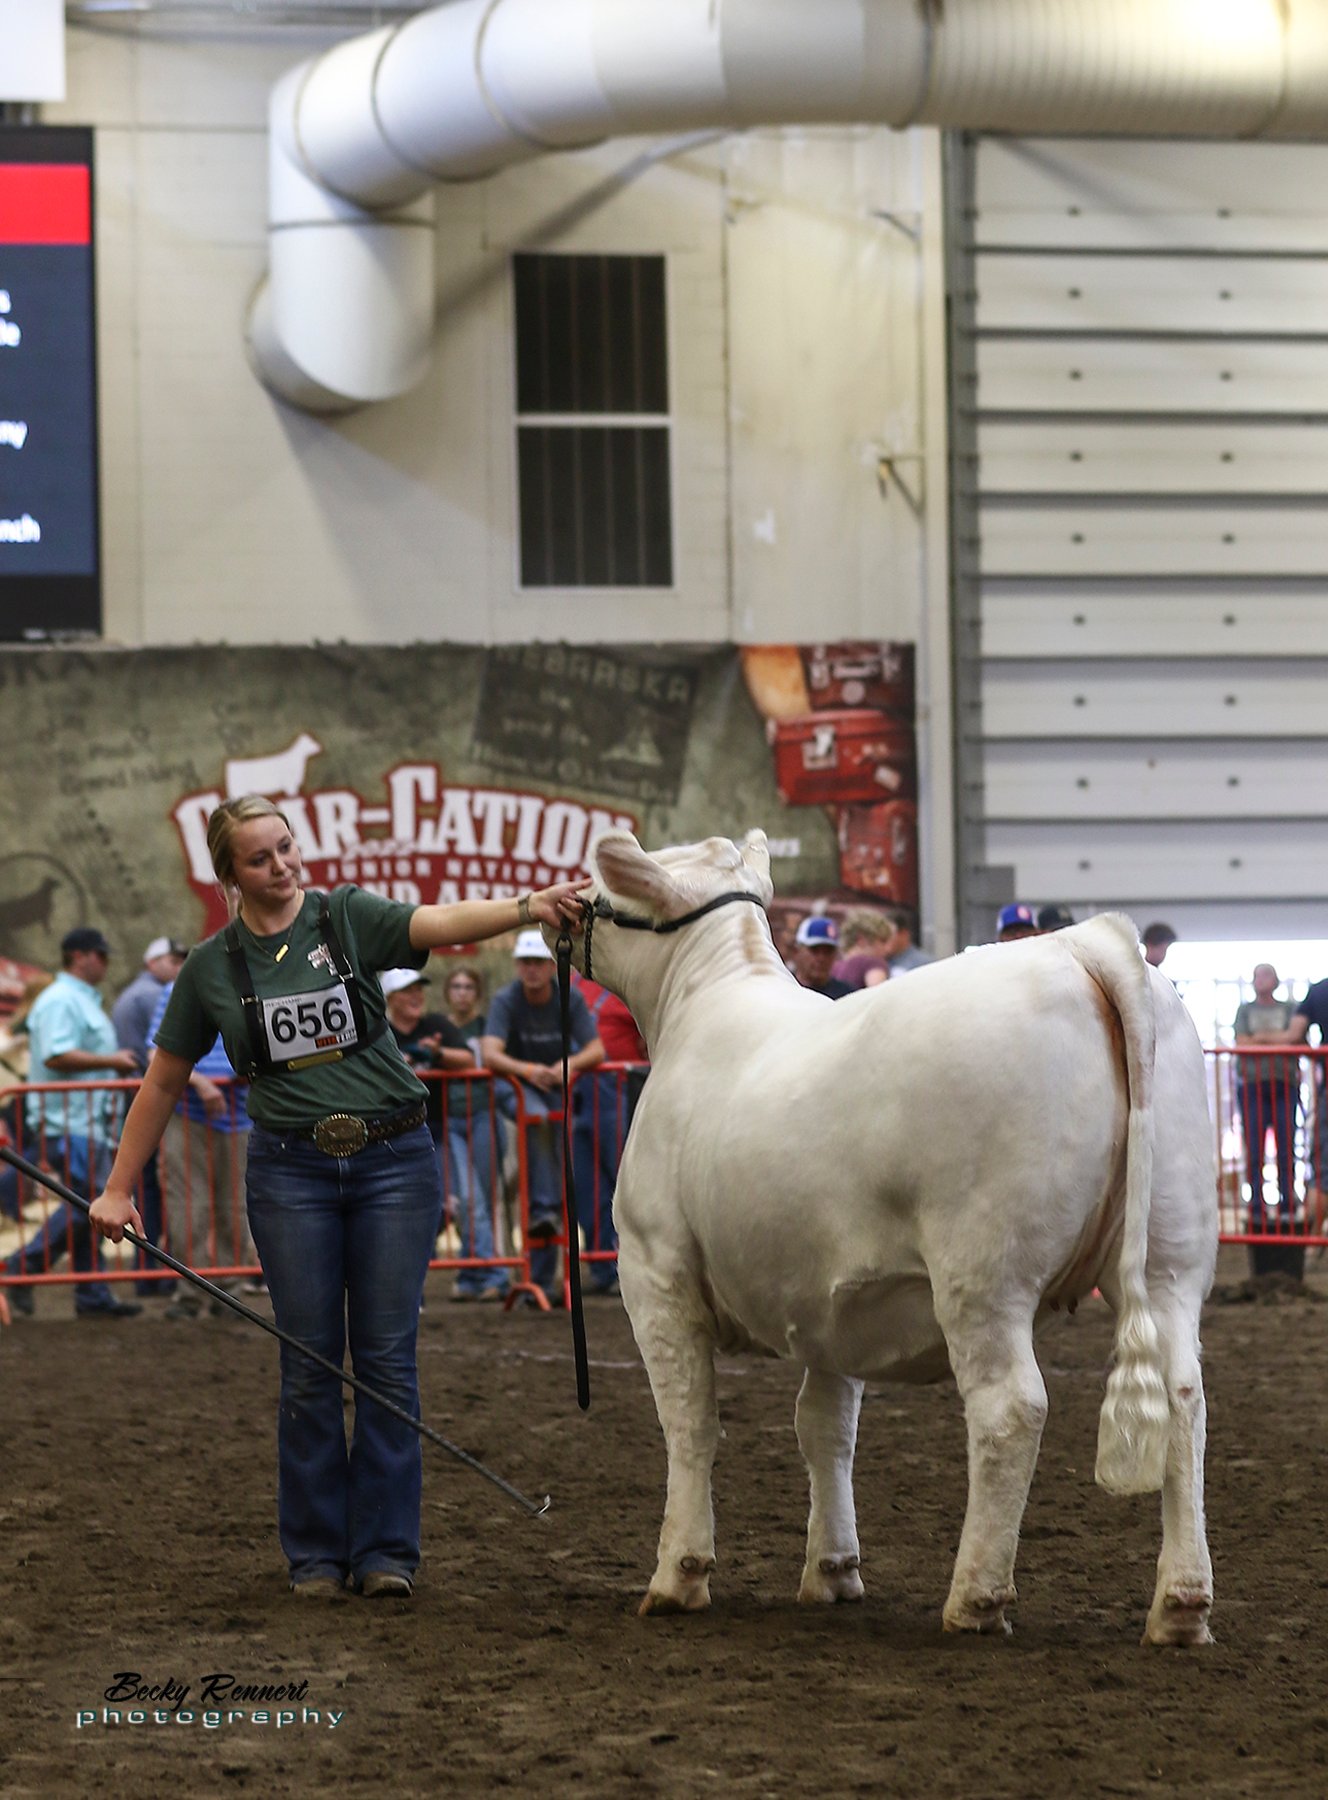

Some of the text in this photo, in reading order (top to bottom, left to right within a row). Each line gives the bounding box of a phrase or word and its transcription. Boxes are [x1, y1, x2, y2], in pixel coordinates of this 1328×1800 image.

[175, 766, 634, 884] CAR-CATION
[327, 857, 431, 882] JUNIOR
[271, 997, 347, 1043] 656
